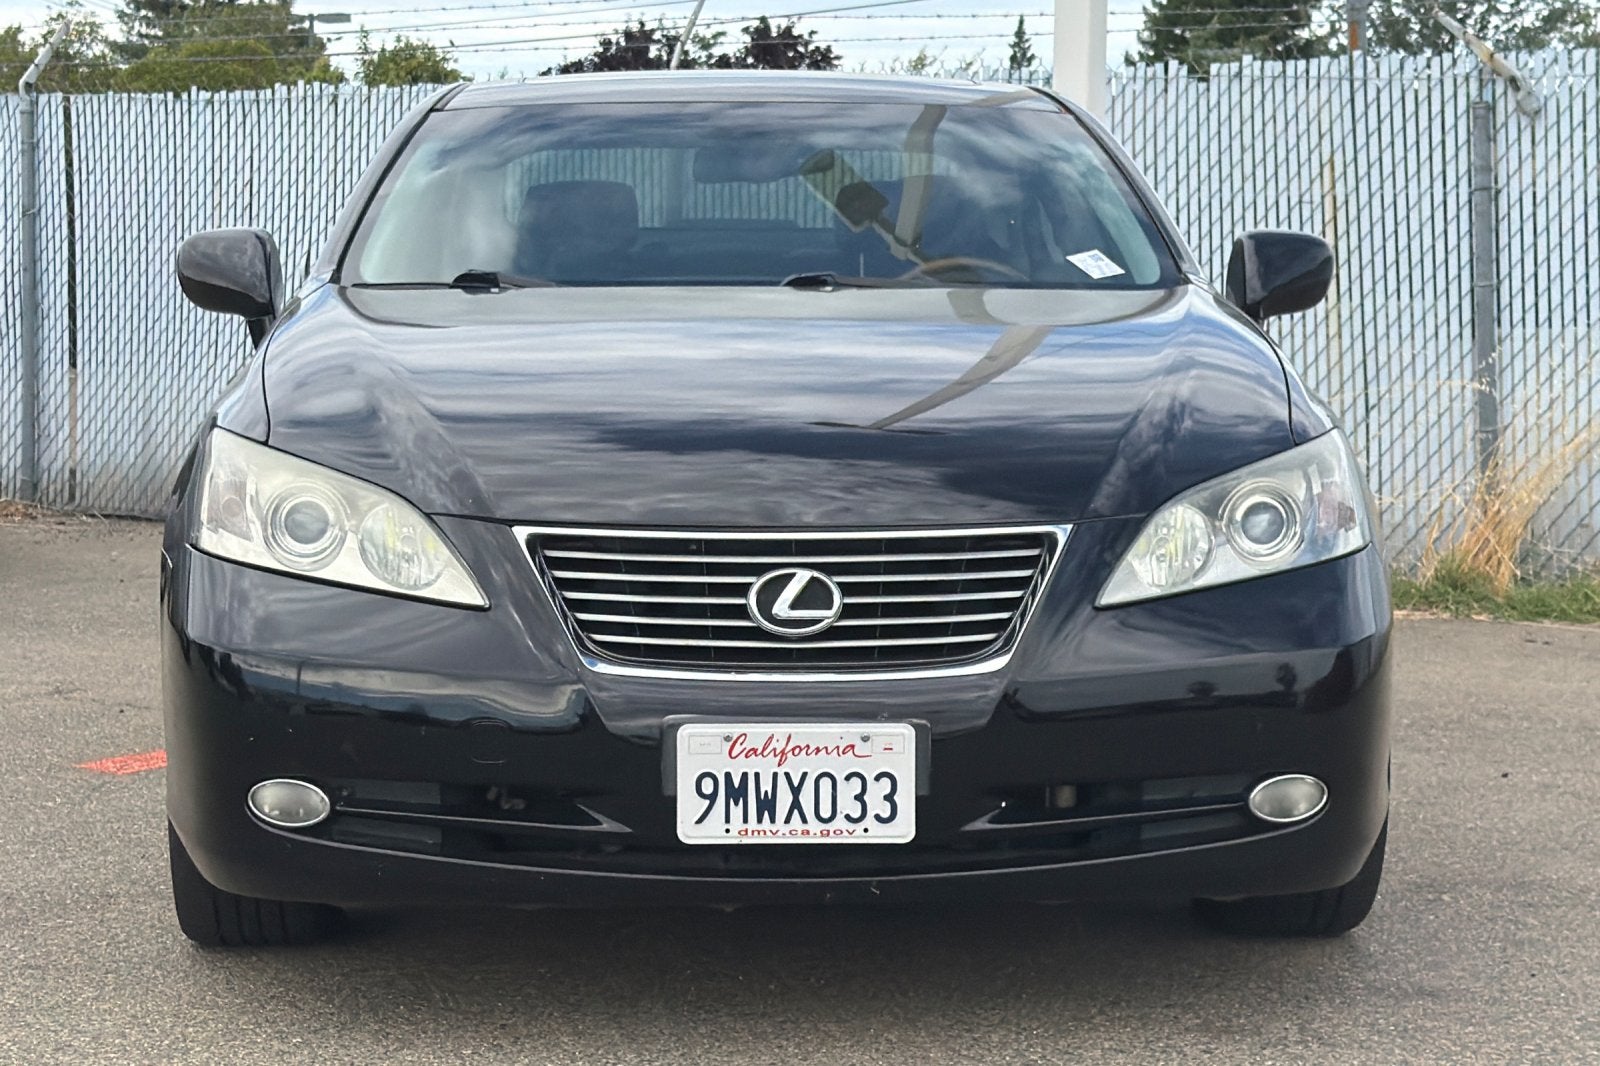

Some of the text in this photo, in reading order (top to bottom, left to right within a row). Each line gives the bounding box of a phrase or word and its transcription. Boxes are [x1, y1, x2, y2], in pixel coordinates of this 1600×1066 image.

[728, 733, 872, 767] California
[694, 771, 898, 825] 9MWX033
[737, 827, 857, 837] dmv.ca.gov
